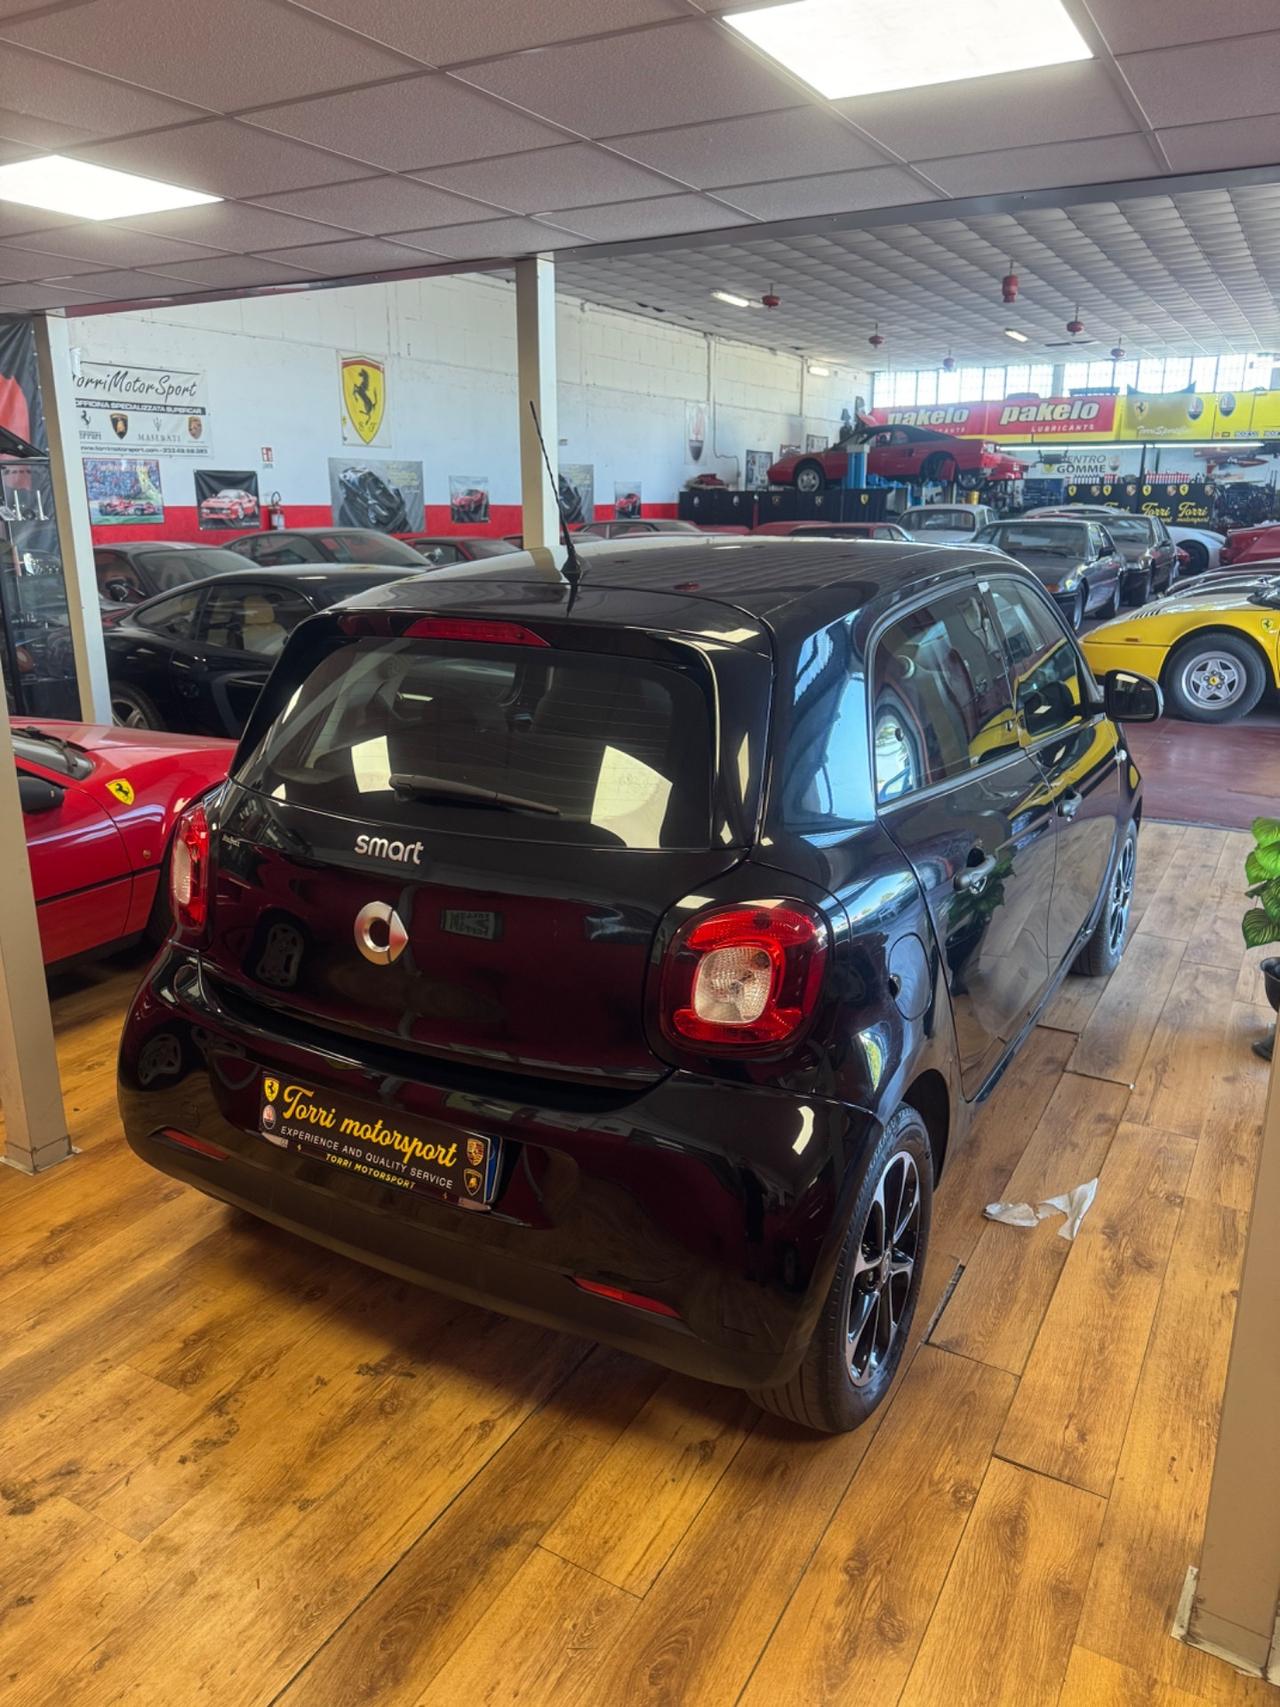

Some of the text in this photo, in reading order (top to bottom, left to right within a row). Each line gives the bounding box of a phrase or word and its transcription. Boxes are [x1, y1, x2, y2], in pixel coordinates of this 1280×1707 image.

[1000, 400, 1099, 425] pakelo
[1031, 424, 1094, 433] LUBRICANTS
[1057, 464, 1106, 474] GOMME
[1066, 455, 1106, 464] ENTRO
[1141, 502, 1171, 517] Torri
[1178, 501, 1208, 517] Torri
[354, 834, 424, 865] smart
[282, 1084, 458, 1167] Torri motorsport
[280, 1126, 453, 1189] EXPERIENCE AND QUALITY SERVICE
[325, 1153, 416, 1190] TORRI MOTORSPORT
